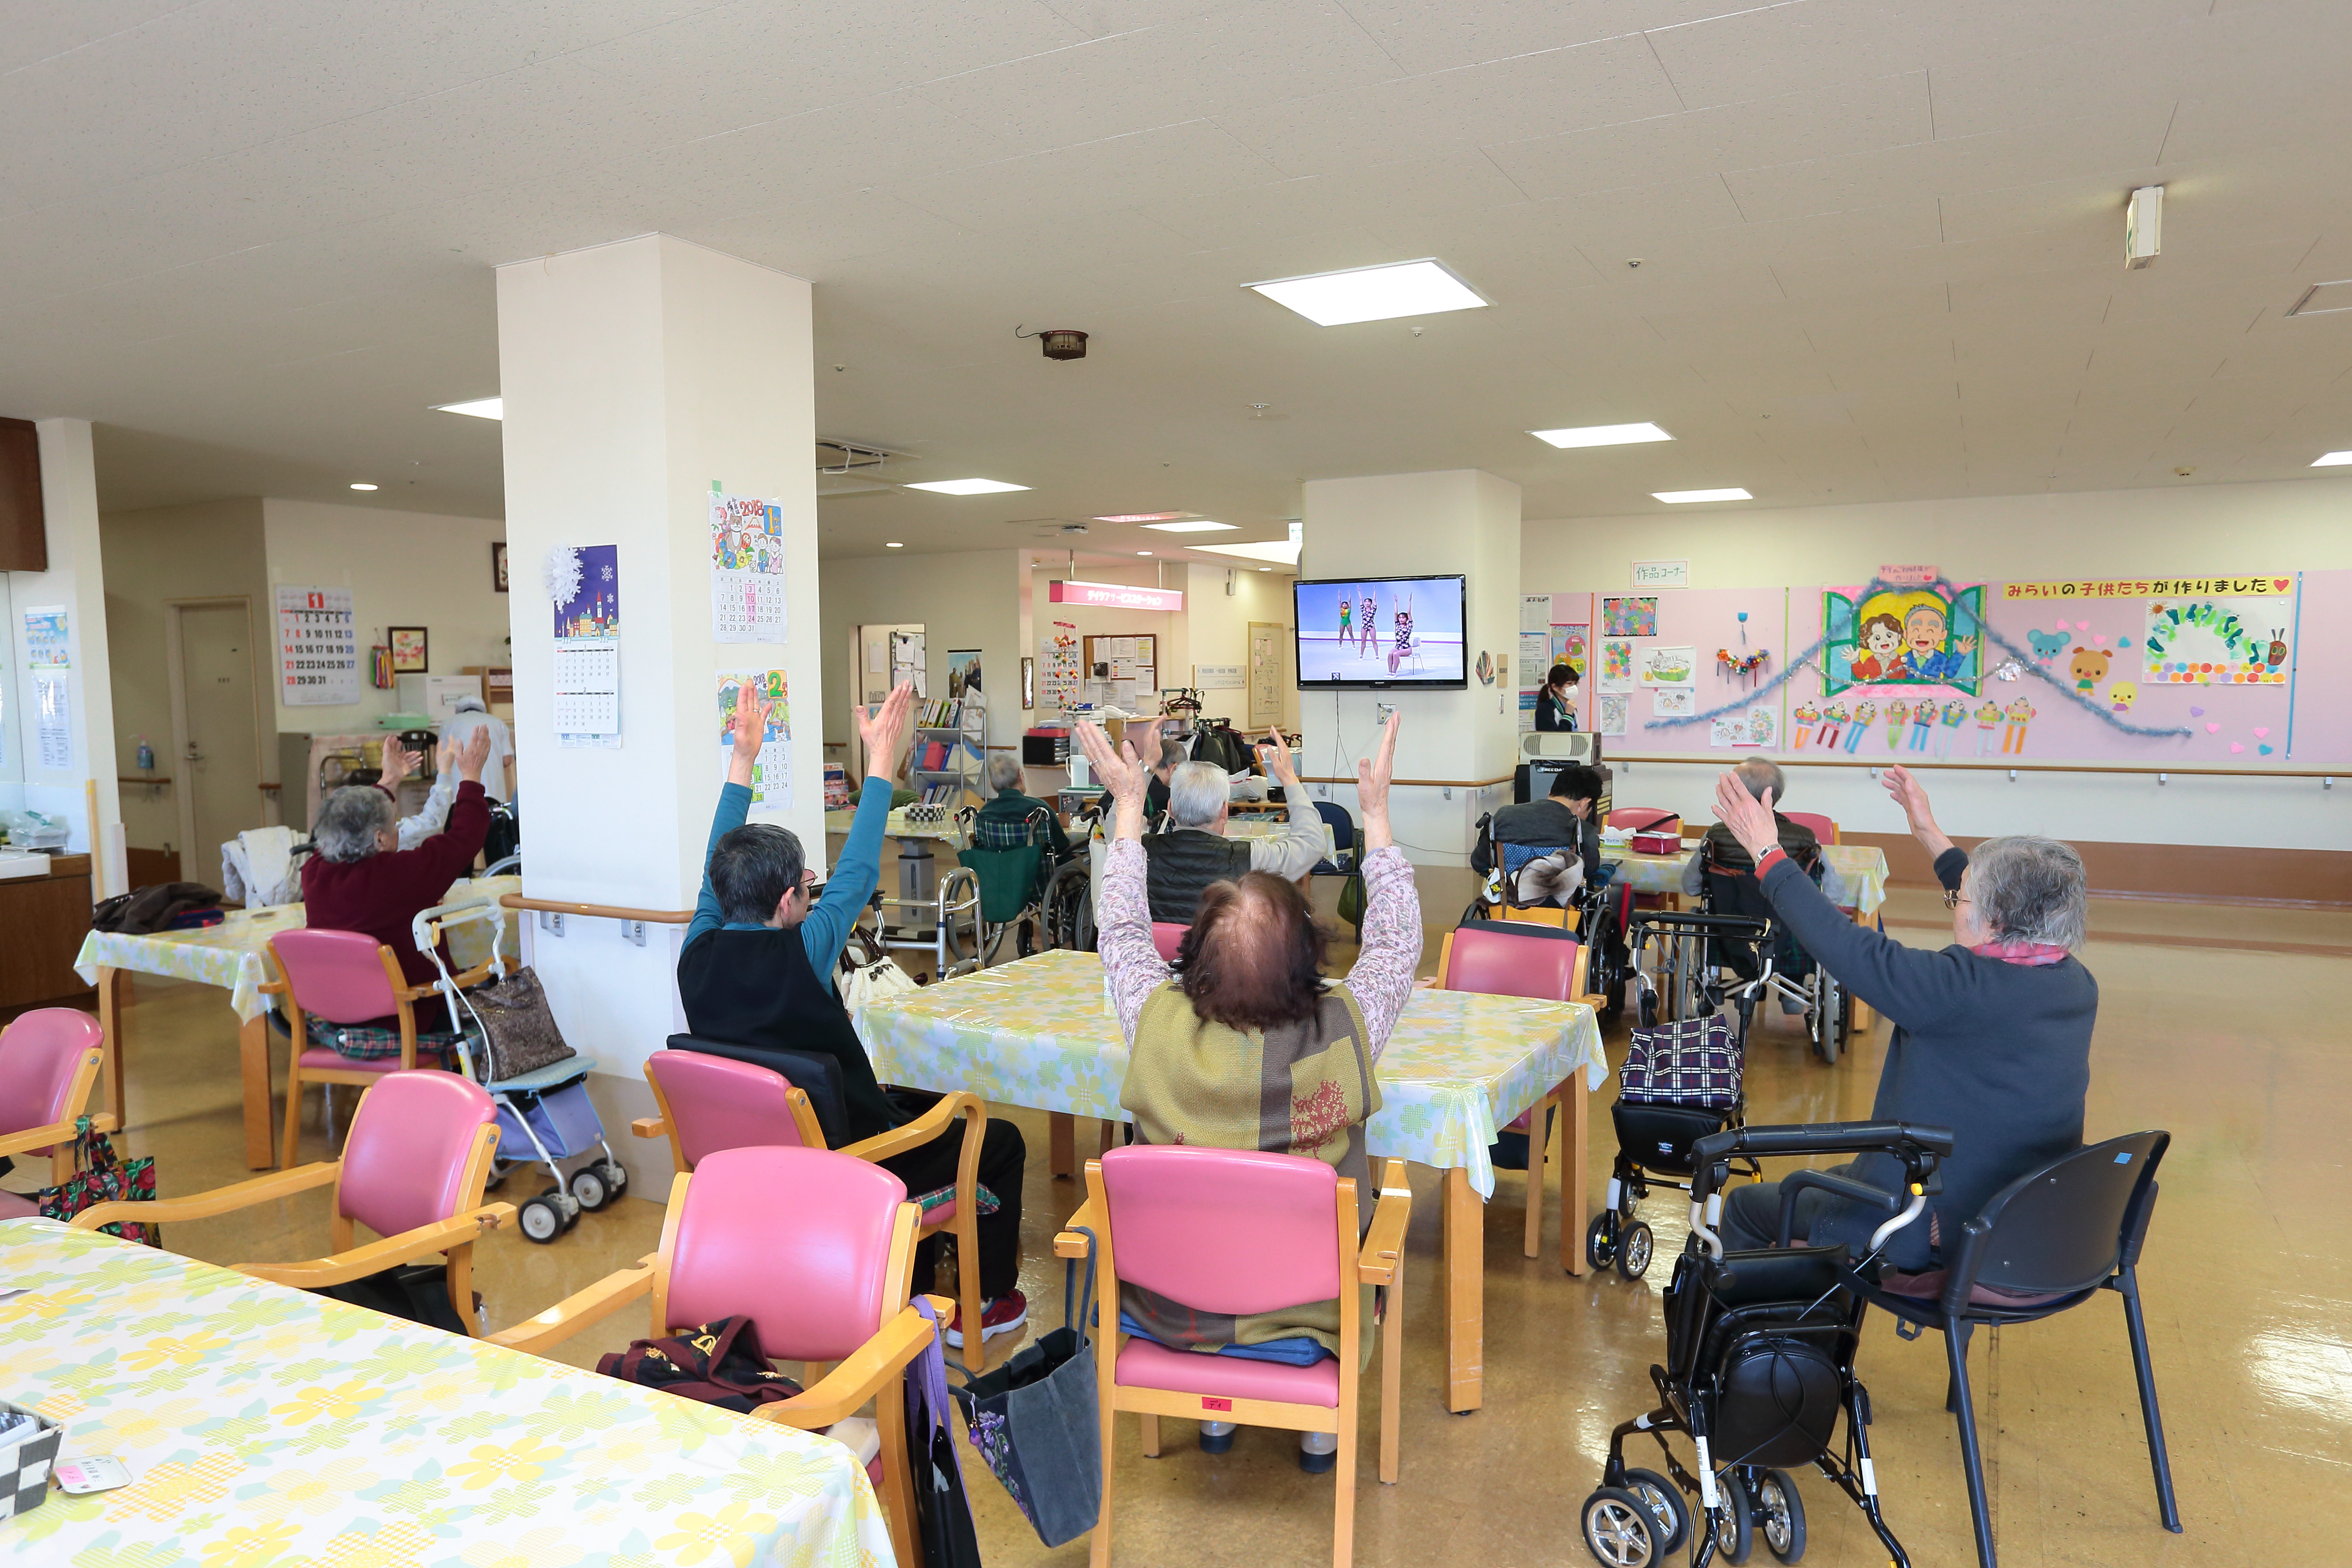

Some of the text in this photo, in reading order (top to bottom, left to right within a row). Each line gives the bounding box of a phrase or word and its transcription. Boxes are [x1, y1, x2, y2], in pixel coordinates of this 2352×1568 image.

[740, 499, 764, 516] 2018
[1637, 567, 1686, 580] 作品コーナー
[2007, 578, 2267, 597] みらいの子供たちが作りました
[295, 614, 349, 623] 1 2 3 4 5 6
[285, 629, 352, 638] 7 8 9 10 11 12 13
[285, 645, 353, 653] 14 15 16 17 18 19 20
[285, 661, 354, 669] 21 22 23 24 25 26 27
[286, 676, 326, 685] 28 29 30 31
[1209, 1400, 1222, 1409] デイ
